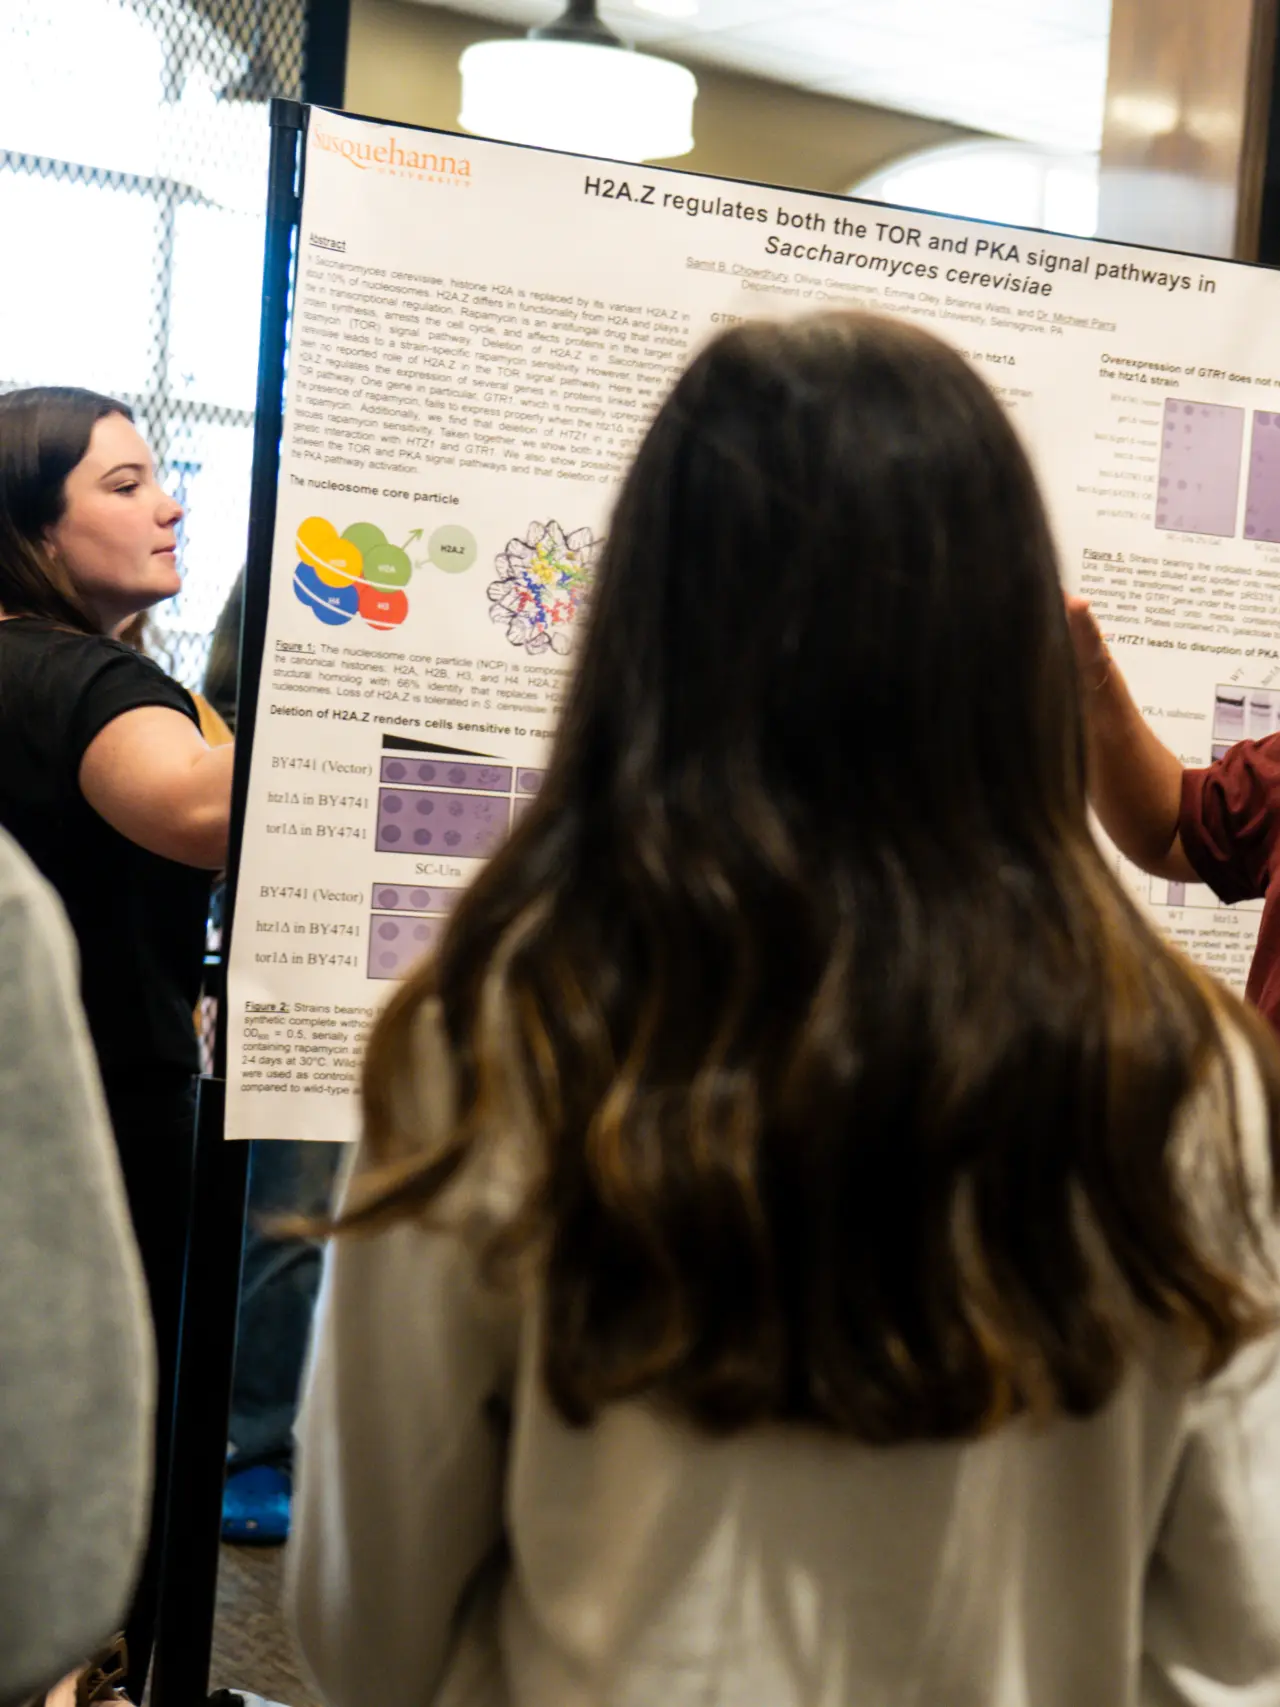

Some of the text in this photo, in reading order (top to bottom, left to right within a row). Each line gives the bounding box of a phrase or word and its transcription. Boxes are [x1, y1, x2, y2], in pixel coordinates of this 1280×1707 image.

[312, 124, 471, 177] Susquehanna
[584, 176, 1216, 293] H2A.Z regulates both the TOR and PKA signal pathways in
[764, 236, 1052, 296] Saccharomyces cerevisiae
[1100, 353, 1181, 372] Overexpression
[1184, 366, 1195, 375] of
[1198, 367, 1226, 379] GTR1
[1228, 373, 1252, 384] does
[1254, 378, 1272, 386] not
[290, 474, 459, 505] The nucleosome core particle
[275, 640, 303, 653] Figure
[1117, 634, 1144, 645] HTZ1
[1147, 638, 1174, 648] leads
[1176, 640, 1187, 650] to
[1190, 642, 1242, 655] disruption
[1244, 648, 1255, 656] of
[1257, 648, 1279, 659] PKA
[270, 704, 313, 717] Deletion
[316, 708, 329, 718] of
[332, 710, 370, 722] H2A.Z
[373, 715, 420, 727] renders
[424, 719, 453, 730] cells
[456, 722, 511, 734] sensitive
[514, 726, 526, 736] to
[272, 756, 372, 776] BY4741 (Vector)
[302, 793, 314, 805] in
[318, 794, 368, 808] BY4741
[300, 826, 312, 836] in
[316, 824, 366, 839] BY4741
[415, 863, 462, 877] SC-Ura
[260, 885, 364, 904] BY4741 (Vector)
[293, 922, 306, 934] in
[309, 922, 359, 936] BY4741
[291, 952, 303, 964] in
[307, 952, 357, 967] BY4741
[245, 1002, 276, 1013] Figure
[242, 1042, 348, 1055] containing rapamycin
[240, 1083, 350, 1096] compared to wild-type
